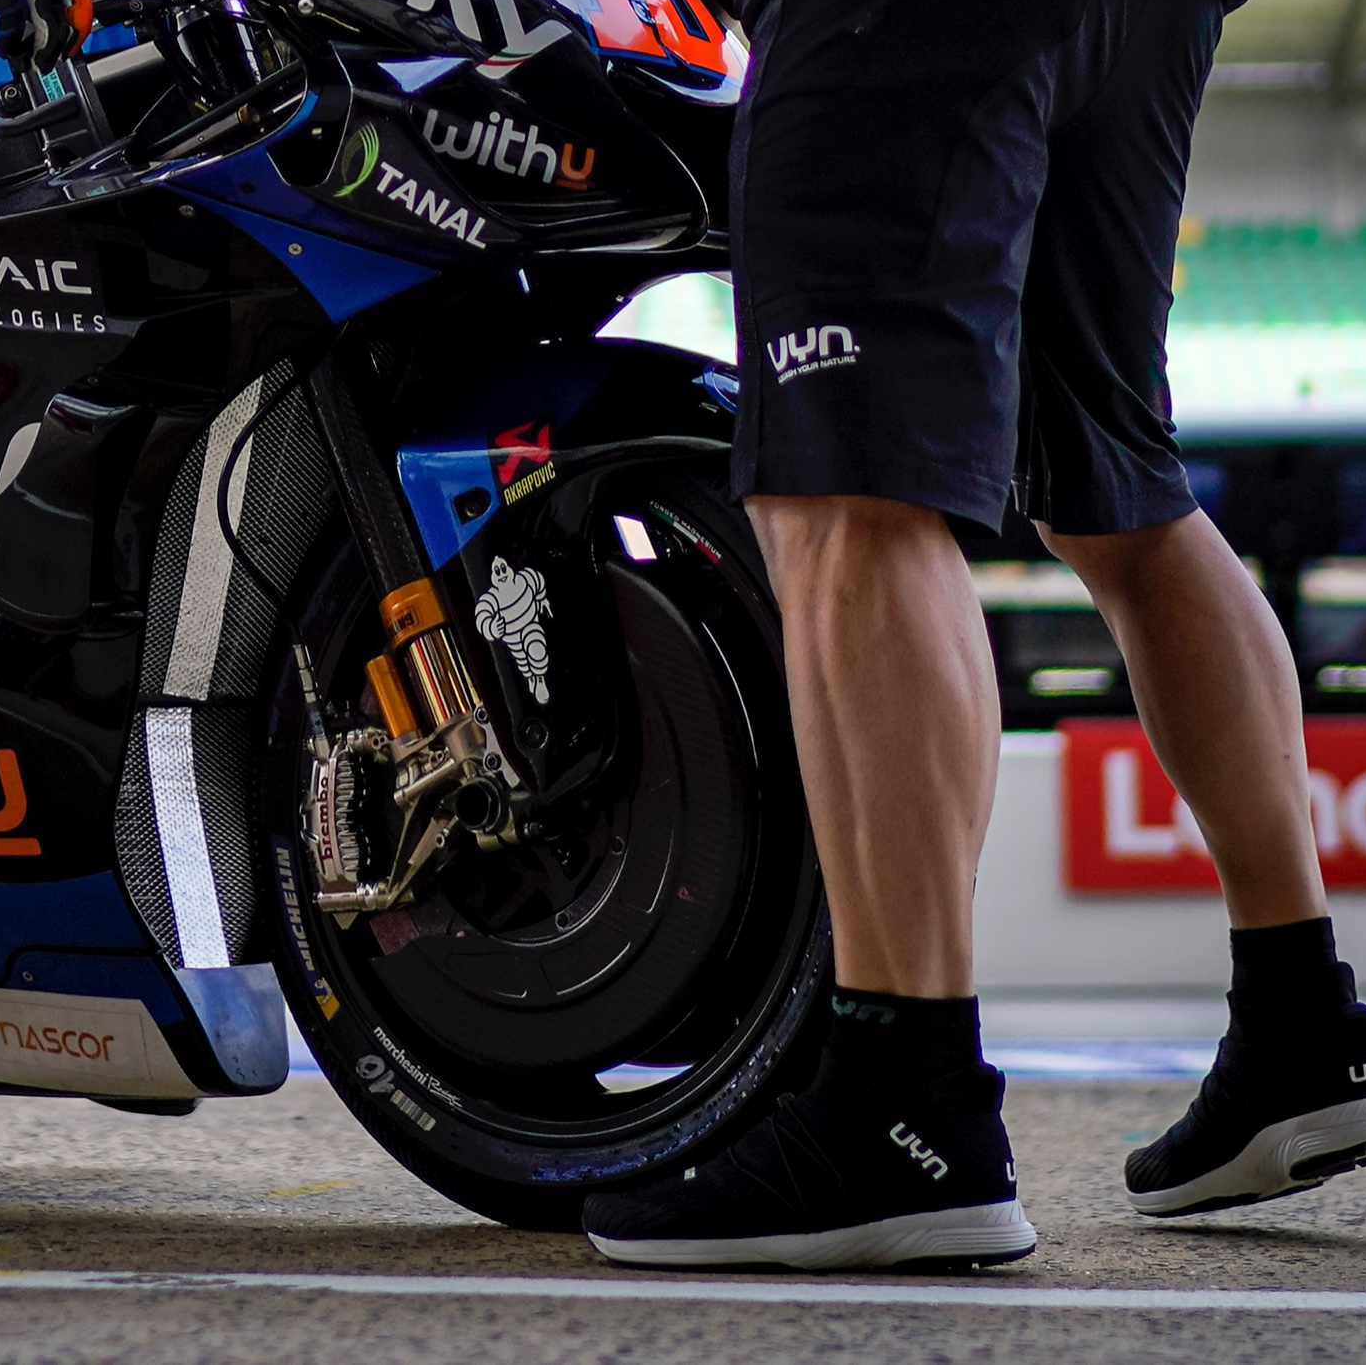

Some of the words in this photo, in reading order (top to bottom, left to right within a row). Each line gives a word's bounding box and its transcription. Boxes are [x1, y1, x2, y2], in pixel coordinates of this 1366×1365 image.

[423, 109, 597, 191] withu
[379, 160, 487, 250] TANAL
[797, 361, 819, 375] YOUR
[820, 354, 857, 368] NATURE
[503, 460, 556, 506] AKRAPOVIC
[650, 500, 680, 521] FORGED
[317, 776, 334, 860] brembo
[276, 847, 315, 972] MICHELIN
[374, 1026, 429, 1086] marchesini
